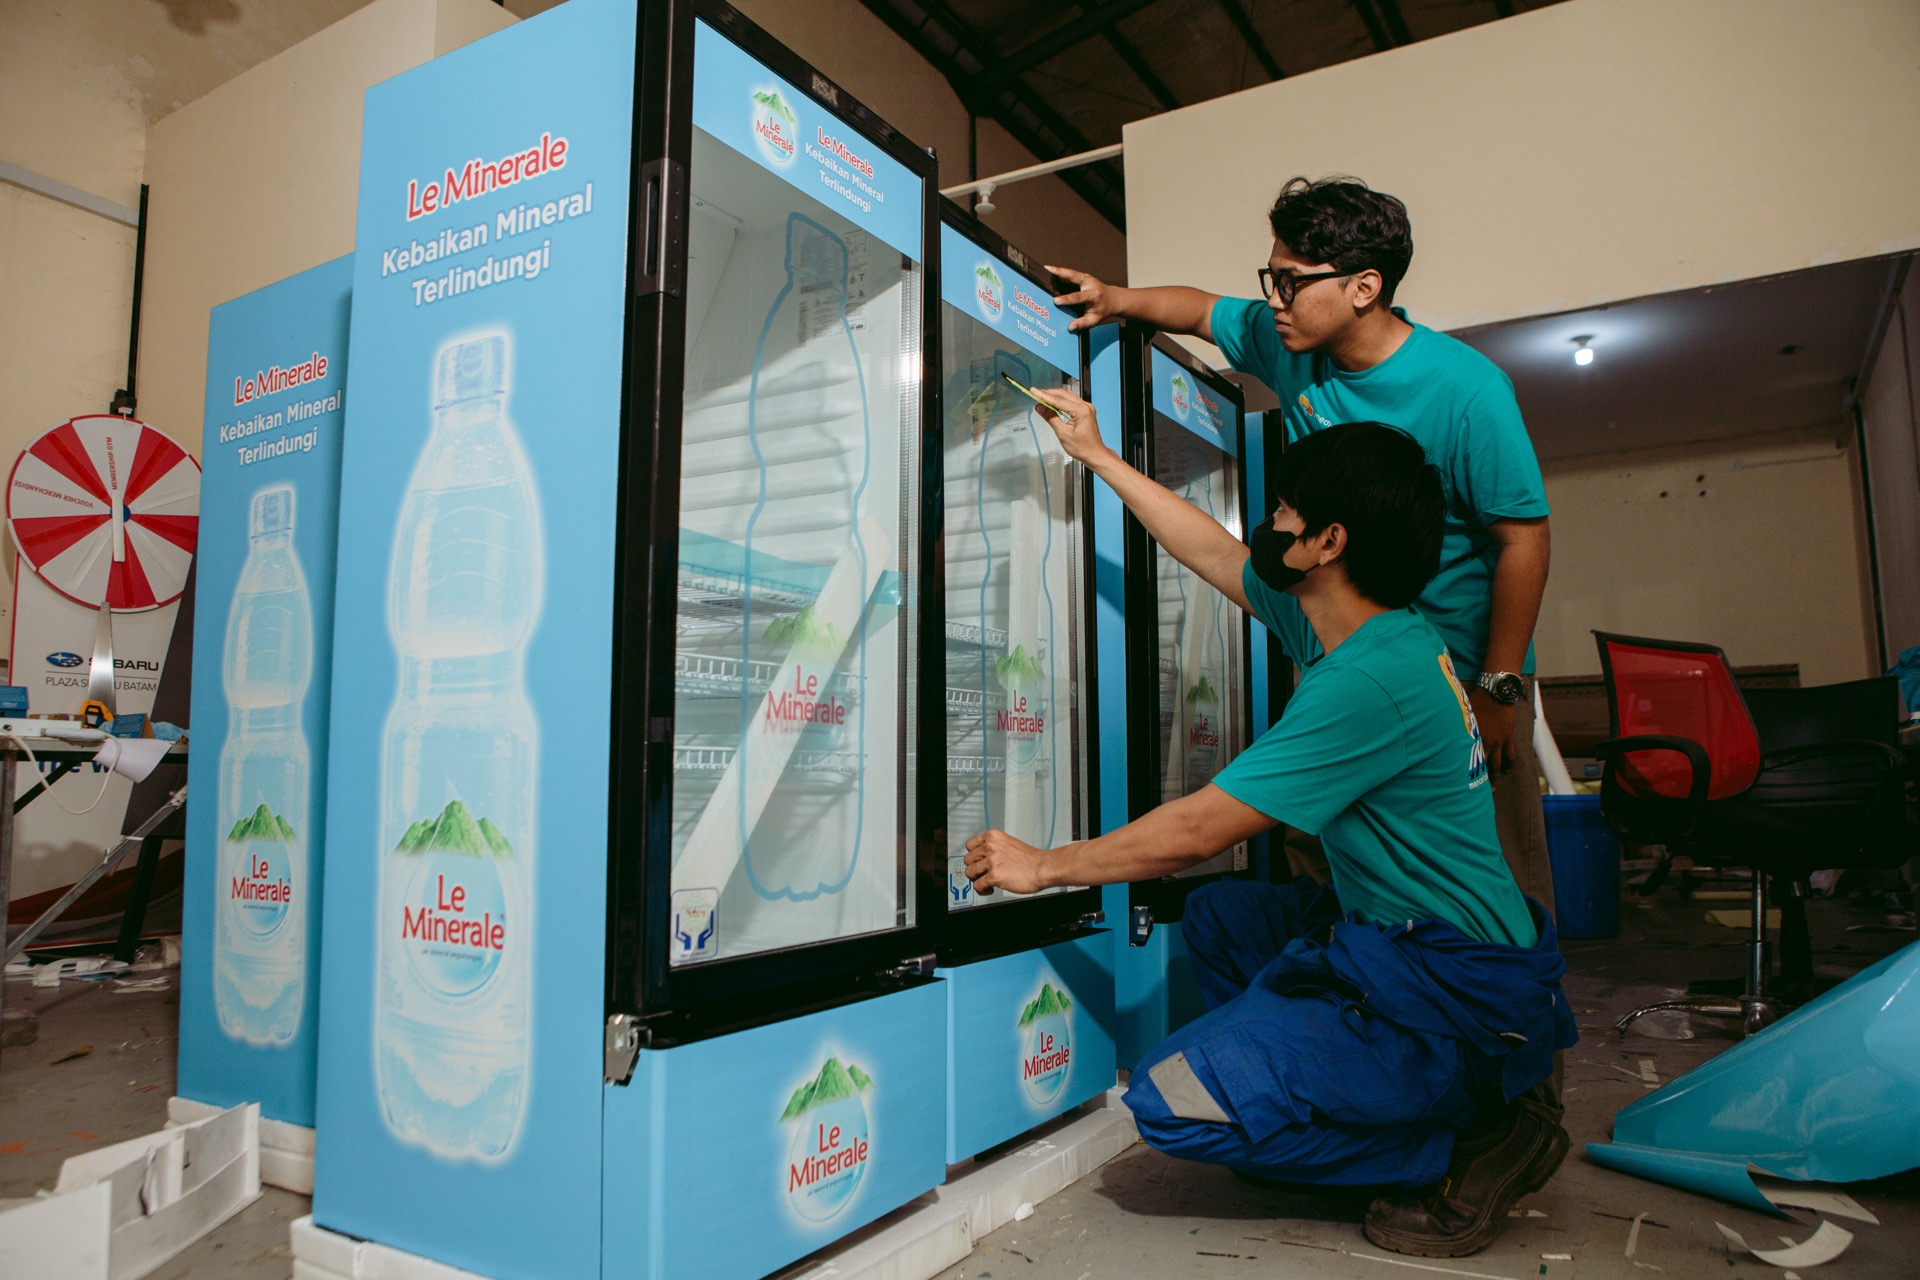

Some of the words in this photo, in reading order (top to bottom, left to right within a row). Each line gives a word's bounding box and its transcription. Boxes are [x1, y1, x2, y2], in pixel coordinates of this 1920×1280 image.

[755, 119, 794, 154] Minerale
[769, 116, 781, 134] Le
[817, 126, 831, 150] Le
[831, 138, 874, 179] Minerale
[407, 181, 439, 219] Le
[442, 133, 568, 207] Minerale
[805, 142, 850, 181] Kebaikan
[851, 172, 884, 204] Mineral
[819, 169, 871, 213] Terlindungi
[381, 223, 488, 277] Kebaikan
[495, 182, 593, 240] Mineral
[411, 240, 550, 306] Terlindungi
[1007, 299, 1035, 325] Kebaikan
[1035, 318, 1057, 339] Mineral
[1014, 286, 1023, 302] Le
[1023, 293, 1049, 320] Minerale
[1016, 319, 1049, 347] Terlindungi
[235, 377, 255, 405] Le
[256, 352, 328, 398] Minerale
[219, 411, 282, 444] Kebaikan
[286, 388, 341, 424] Mineral
[106, 436, 114, 451] GYM
[237, 425, 318, 466] Terlindungi
[107, 451, 118, 491] MEMBERSHIP
[13, 479, 62, 499] MERCHANDISE
[63, 493, 94, 509] VOUCHER
[88, 656, 159, 672] BARU
[796, 664, 818, 697] Le
[45, 676, 79, 687] PLAZA
[123, 681, 157, 692] BATAM
[1013, 689, 1027, 713] Le
[766, 690, 845, 726] Minerale
[996, 709, 1044, 734] Minerale
[1199, 712, 1209, 731] Le
[1189, 728, 1219, 748] Minerale
[251, 853, 269, 880] Le
[231, 876, 291, 903] Minerale
[437, 874, 466, 913] Le
[402, 904, 505, 951] Minerale
[1040, 1031, 1054, 1054] Le
[1024, 1044, 1070, 1081] Minerale
[818, 1122, 841, 1154] Le
[788, 1136, 868, 1194] Minerale
